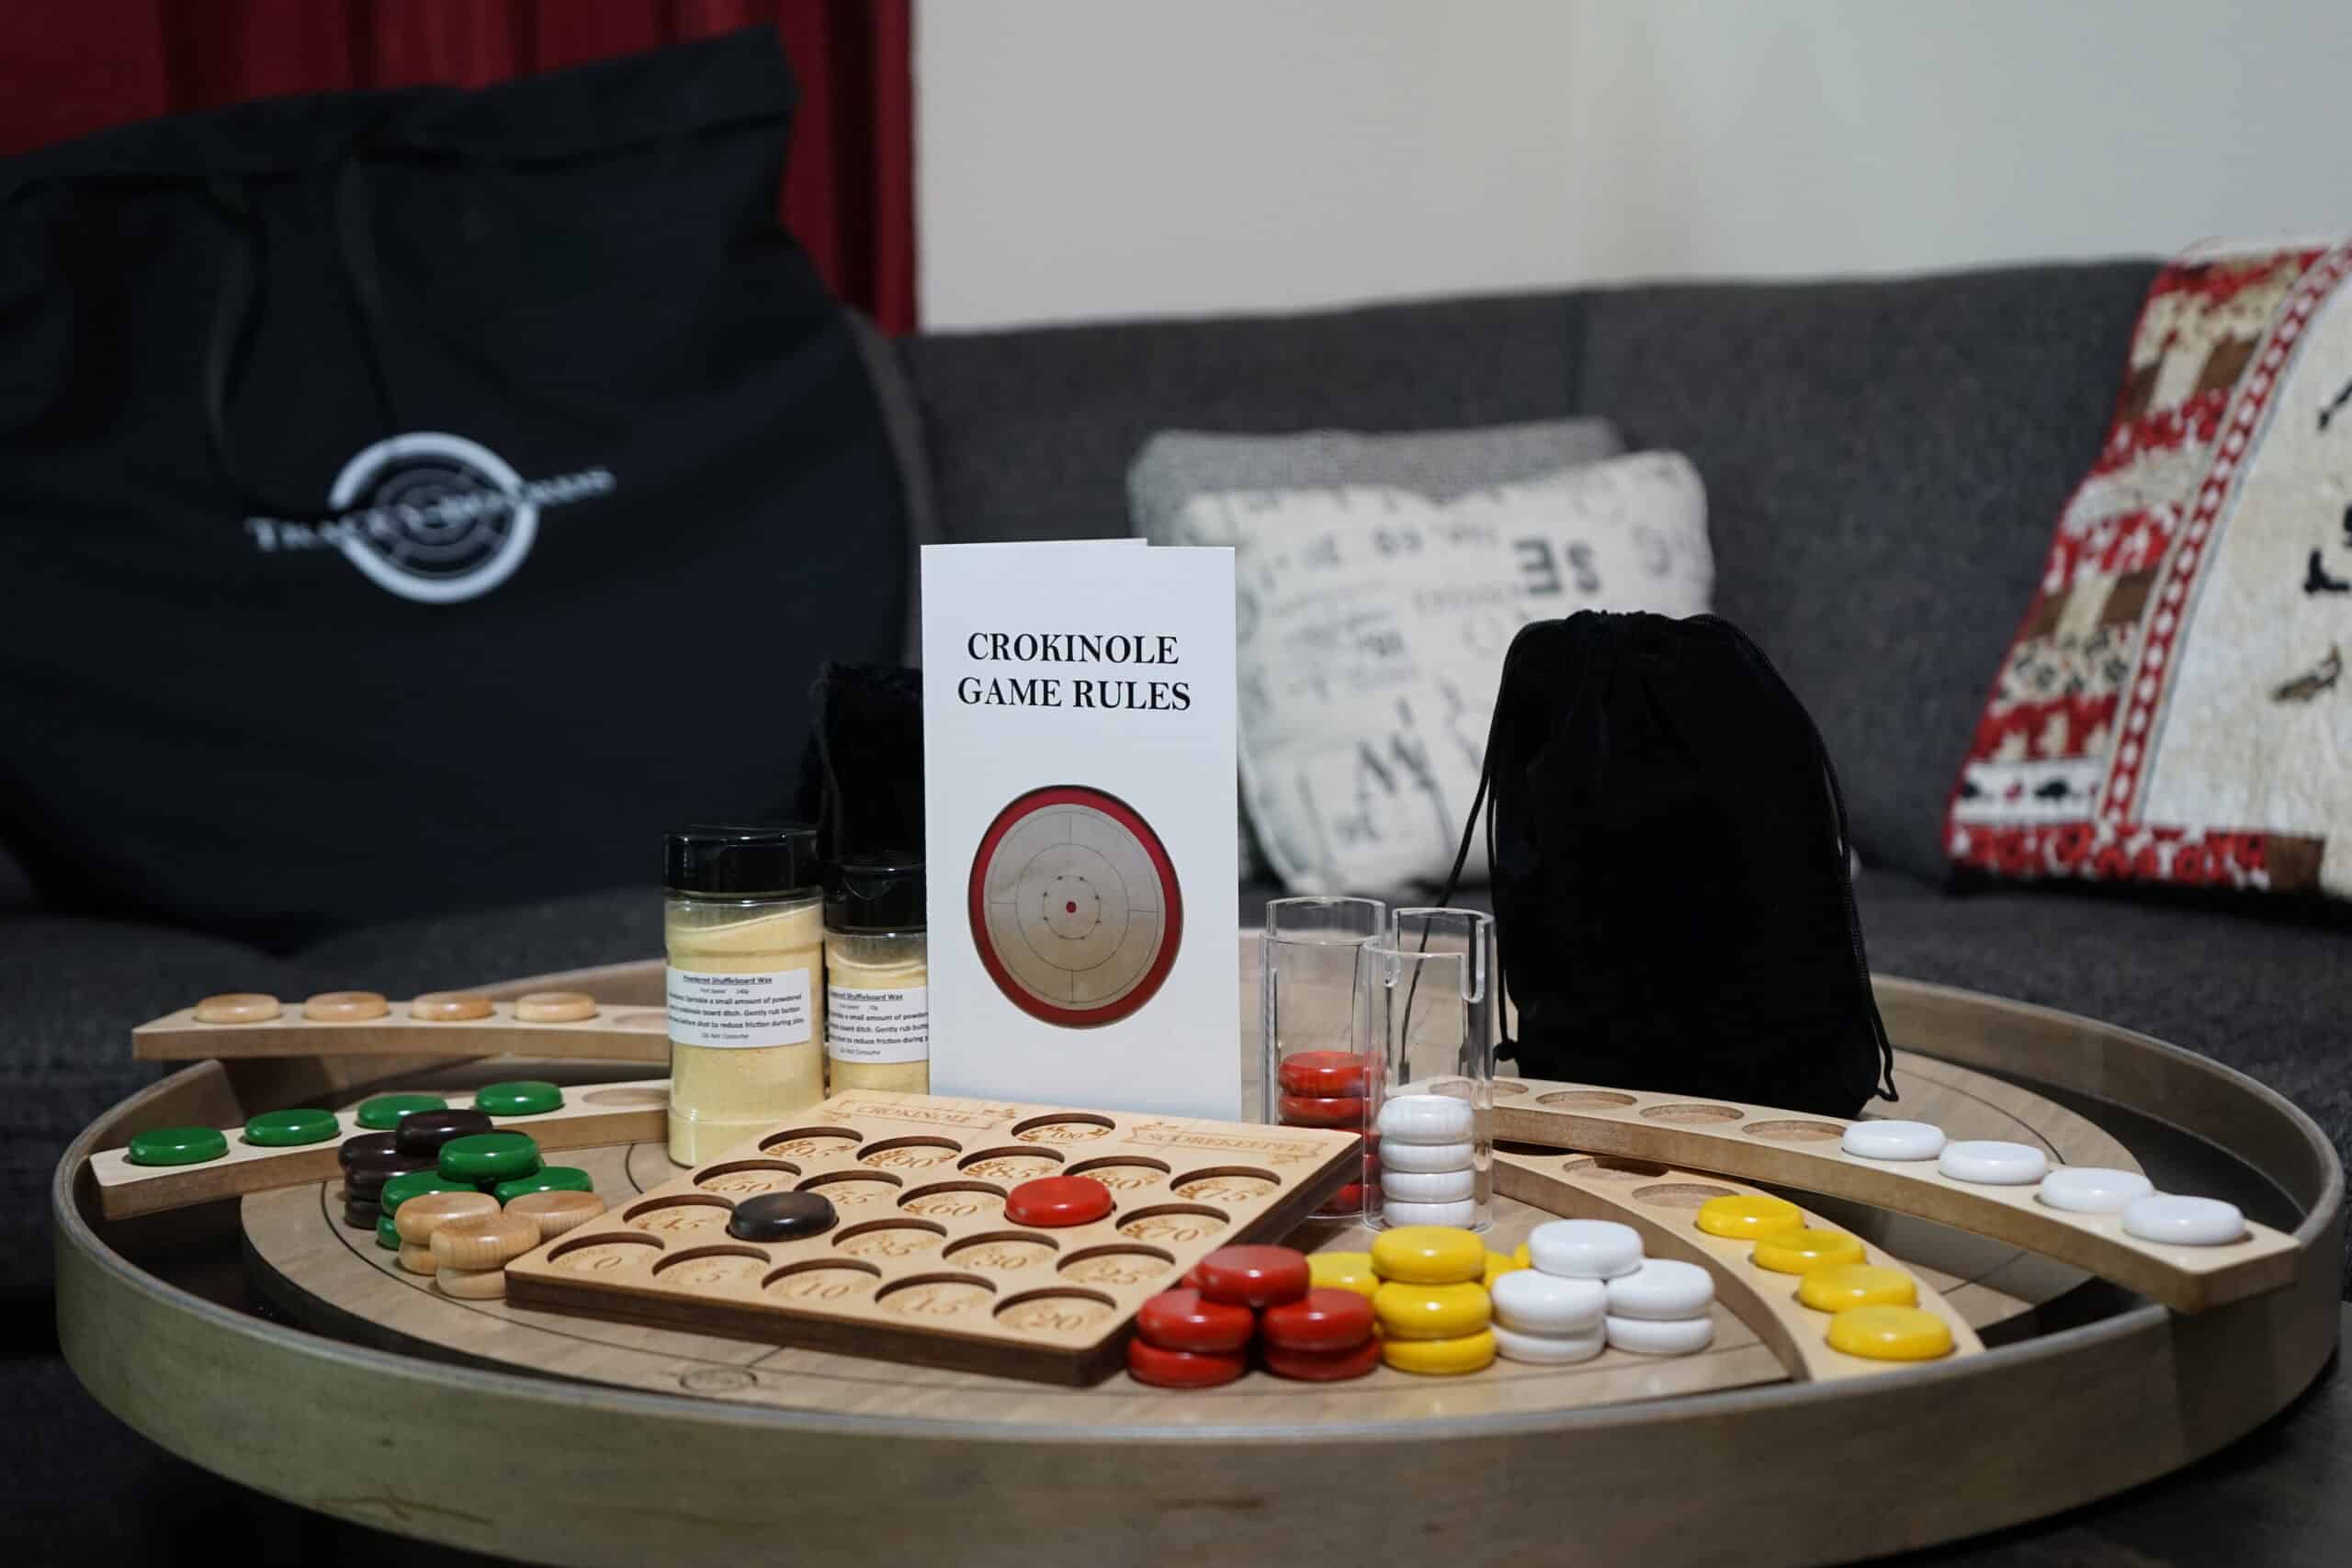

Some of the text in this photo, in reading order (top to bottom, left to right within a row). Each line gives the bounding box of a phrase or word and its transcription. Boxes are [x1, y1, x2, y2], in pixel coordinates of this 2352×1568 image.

[967, 632, 1179, 664] CROKINOLE
[957, 676, 1192, 711] GAME RULES
[711, 976, 755, 986] Shuffleboard
[756, 976, 773, 985] Wax
[715, 996, 733, 1005] small
[763, 996, 772, 1004] of
[772, 993, 802, 1007] powdered
[846, 992, 887, 1002] Shuffleboard
[888, 993, 903, 1002] Wax
[743, 1009, 766, 1019] Gently
[894, 1012, 902, 1021] of
[720, 1020, 742, 1029] reduce
[744, 1020, 770, 1029] friction
[771, 1019, 791, 1028] during
[874, 1024, 898, 1035] Gently
[876, 1036, 902, 1044] friction
[903, 1034, 923, 1044] during
[1049, 1131, 1083, 1141] 100
[987, 1165, 1038, 1179] 85
[927, 1201, 978, 1217] 60
[1154, 1224, 1199, 1242] 70
[594, 1254, 623, 1271] 0
[974, 1250, 1028, 1270] 30
[797, 1280, 851, 1300] 10
[1025, 1308, 1084, 1330] 20
